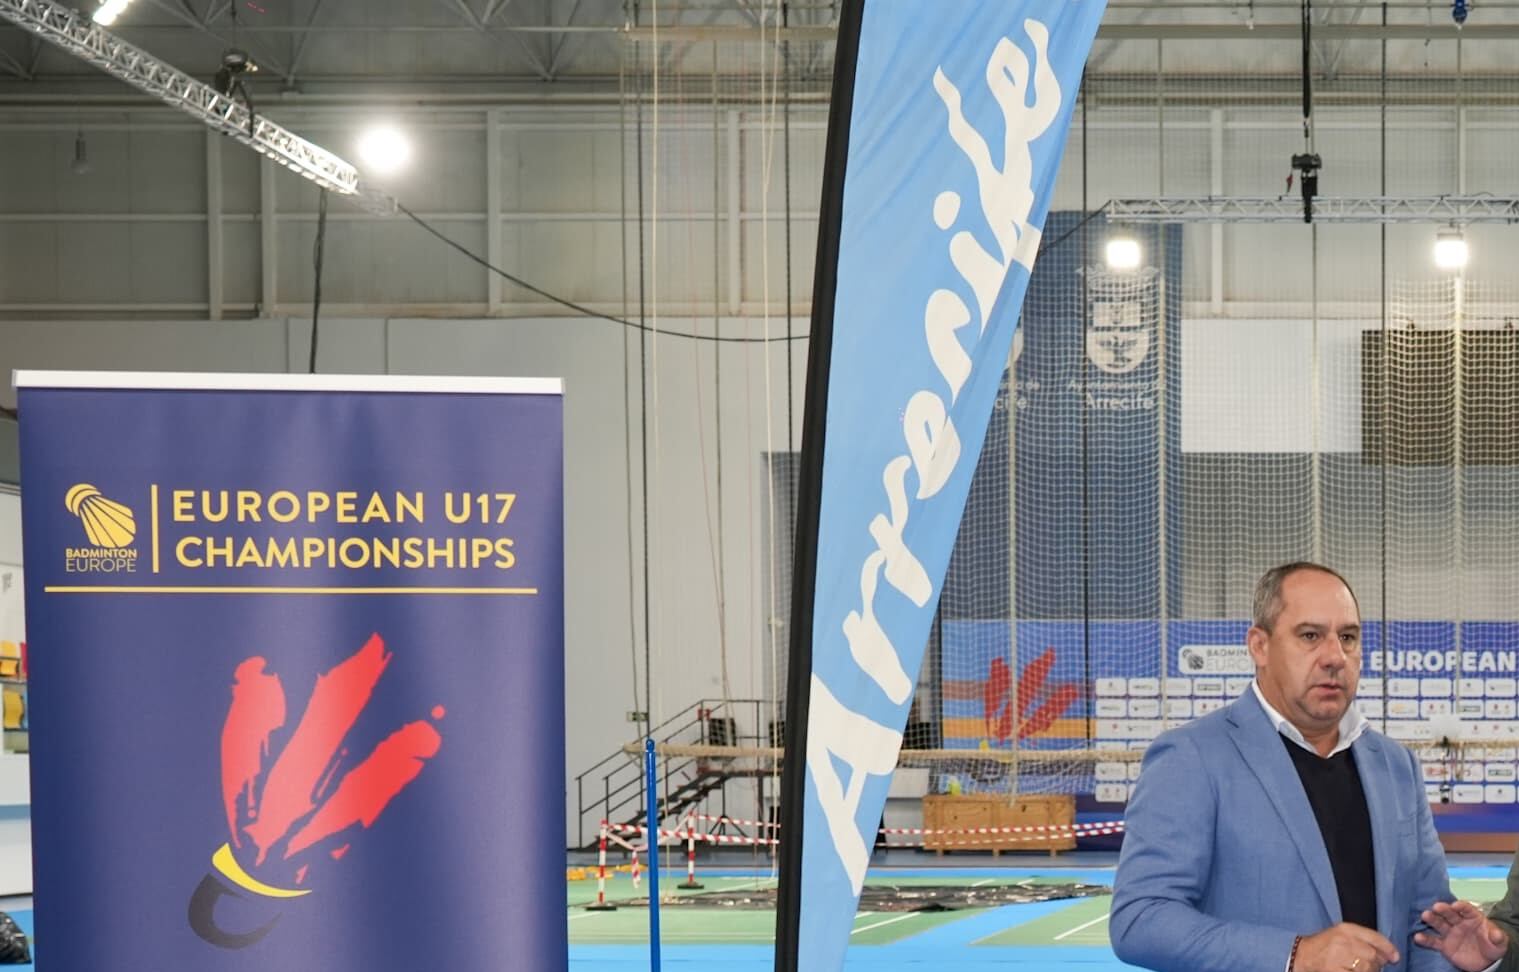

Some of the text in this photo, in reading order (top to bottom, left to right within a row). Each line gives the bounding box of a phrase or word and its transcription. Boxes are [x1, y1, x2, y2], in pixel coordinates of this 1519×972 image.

[806, 18, 1062, 898] Arrecife
[173, 490, 517, 524] EUROPEAN U17
[65, 548, 137, 559] BADMINTON
[175, 537, 517, 569] CHAMPIONSHIPS
[65, 558, 137, 573] EUROPE
[1206, 648, 1249, 657] BADMIN
[1370, 651, 1516, 672] EUROPEAN
